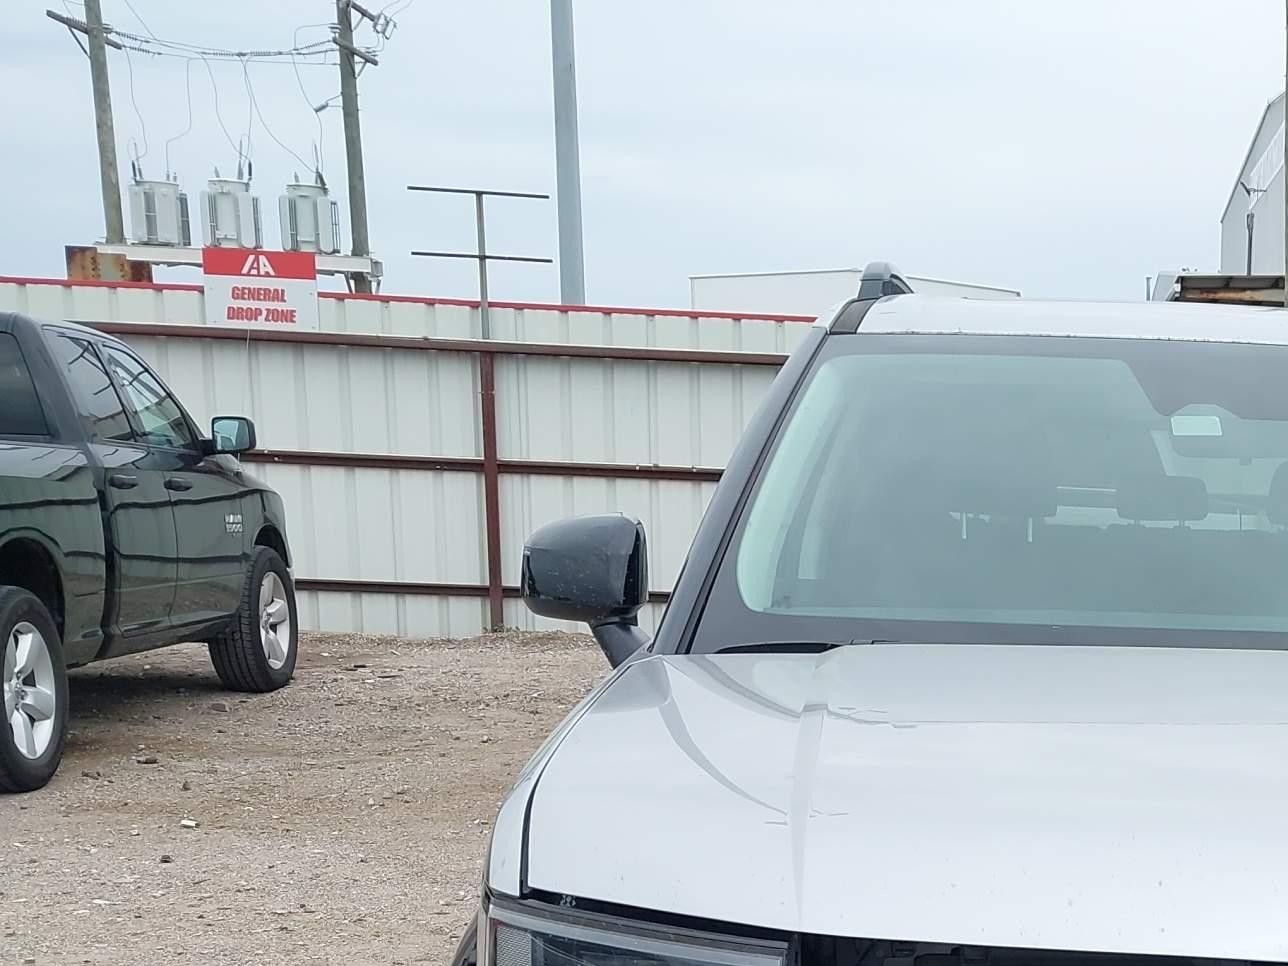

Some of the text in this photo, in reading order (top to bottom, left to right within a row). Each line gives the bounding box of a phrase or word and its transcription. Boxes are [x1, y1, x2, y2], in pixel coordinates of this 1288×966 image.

[231, 286, 287, 303] GENERAL
[227, 306, 297, 323] DROP ZONE
